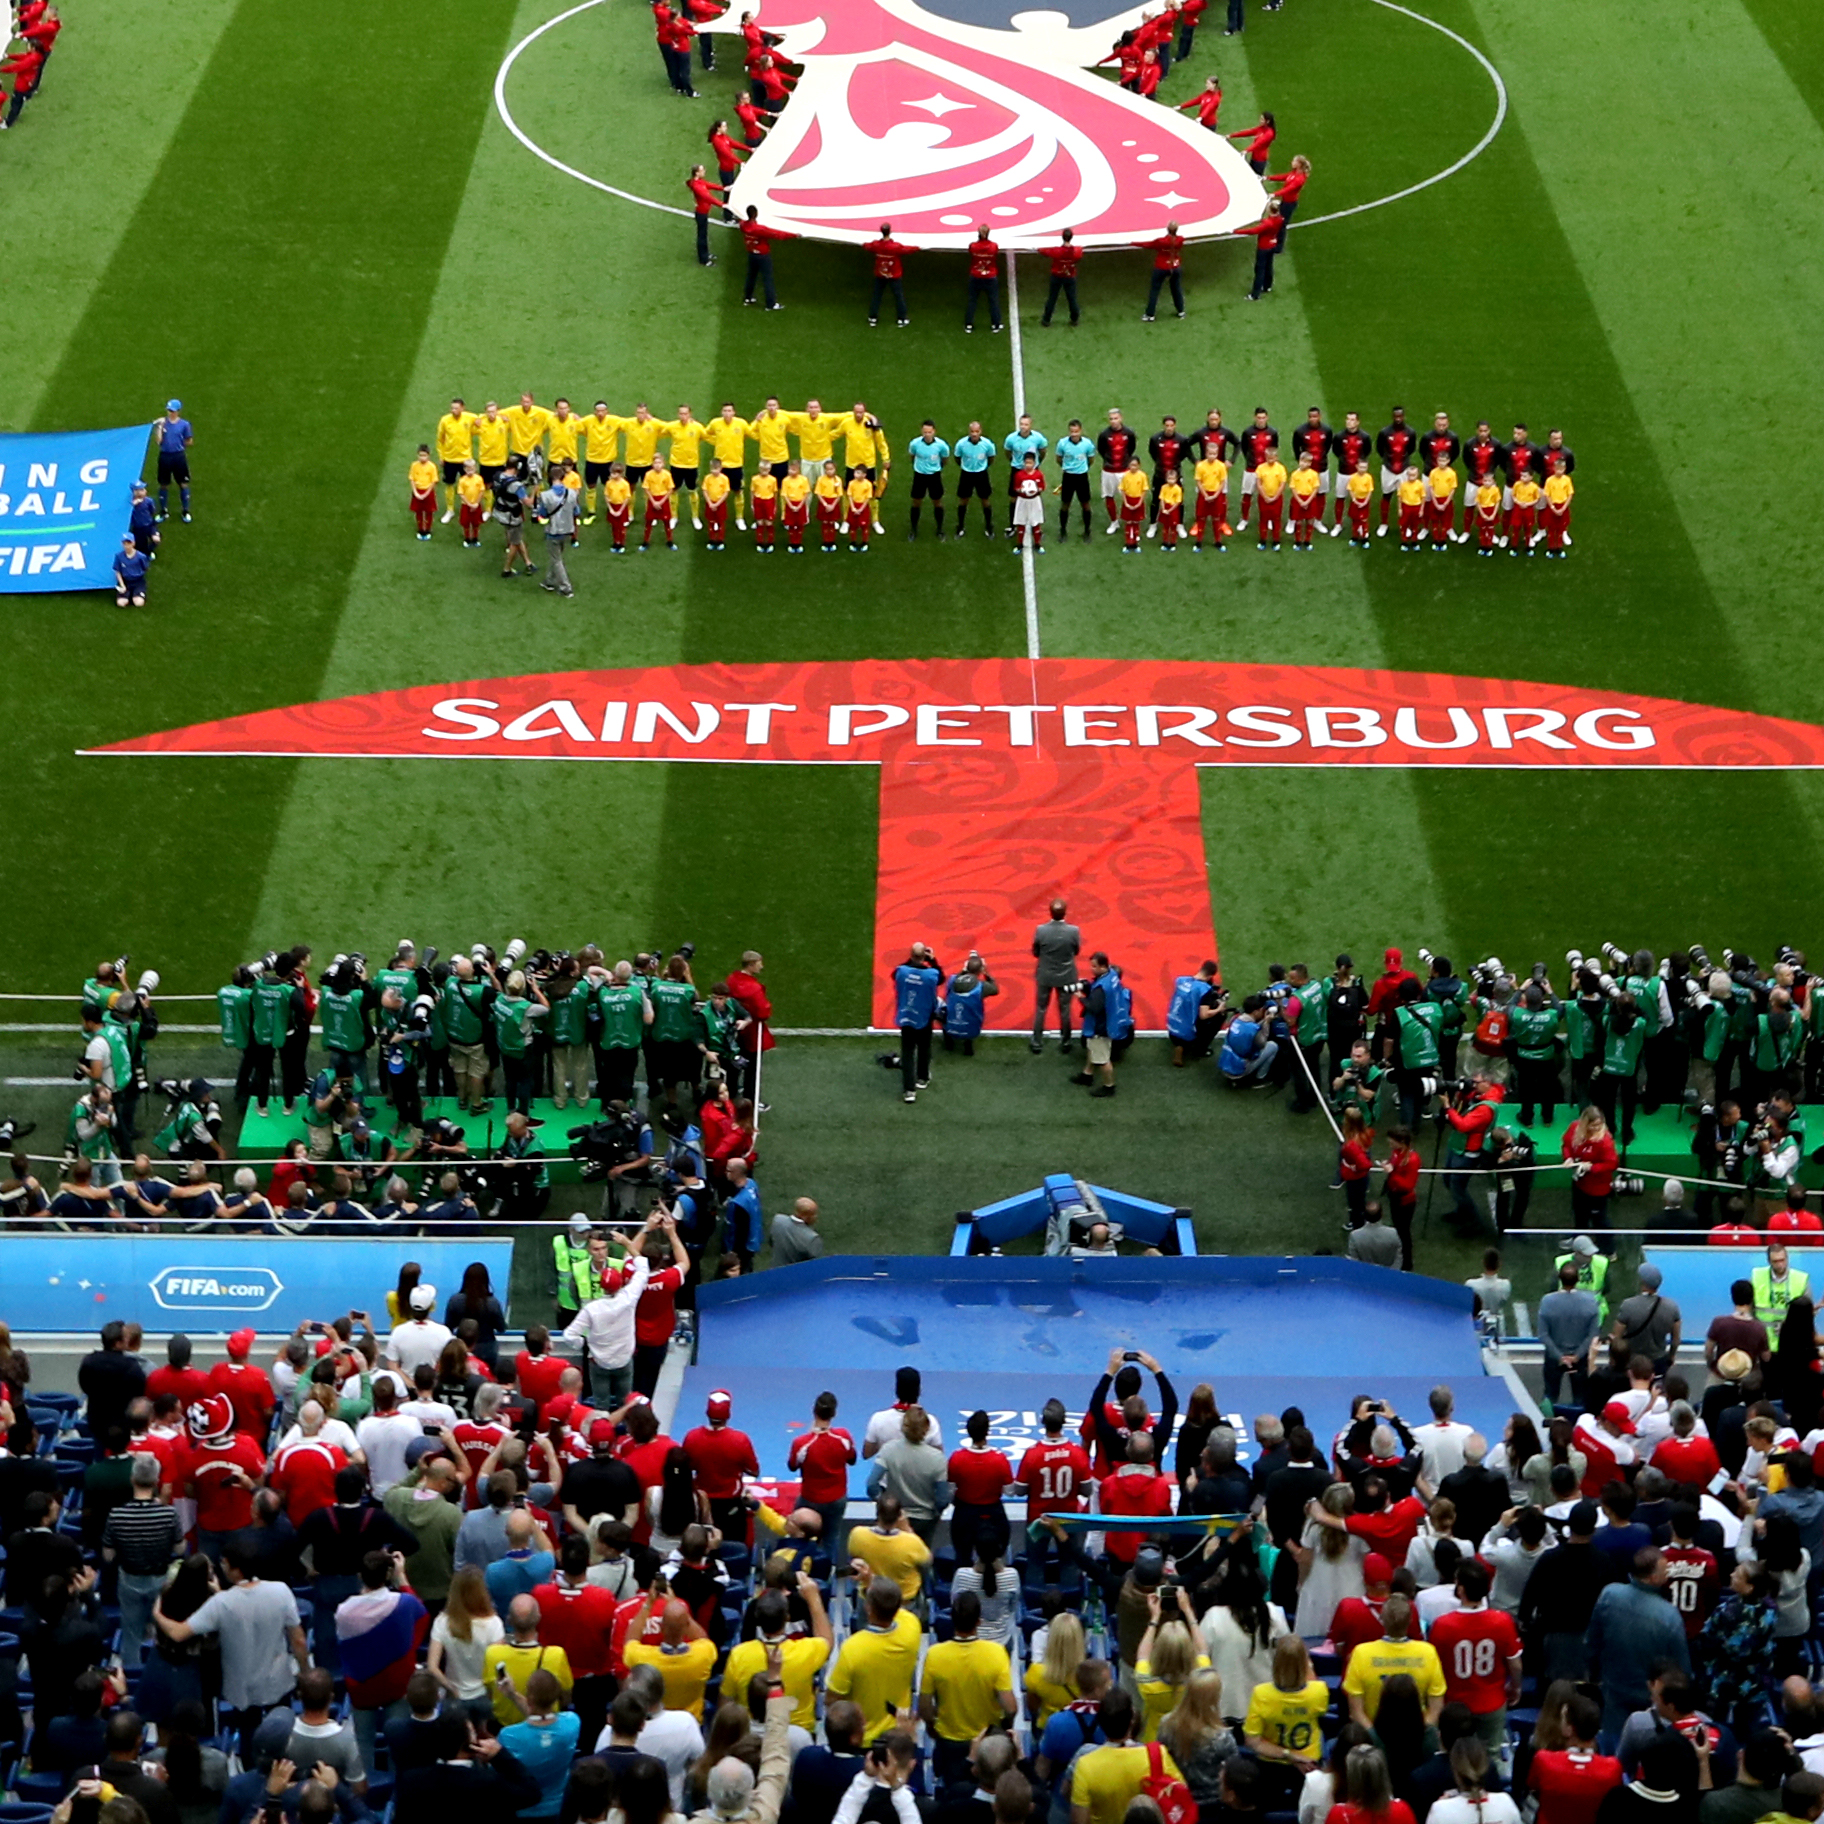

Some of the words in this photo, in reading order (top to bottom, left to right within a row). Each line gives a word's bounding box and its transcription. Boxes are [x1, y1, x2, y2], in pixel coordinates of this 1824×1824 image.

[421, 697, 799, 747] SAINT
[826, 700, 1657, 753] PETERSBURG
[165, 1277, 266, 1297] FIFA.com
[1039, 1465, 1073, 1499] 10
[1669, 1580, 1698, 1612] 10
[1454, 1638, 1496, 1678] 08
[1275, 1722, 1313, 1750] 10
